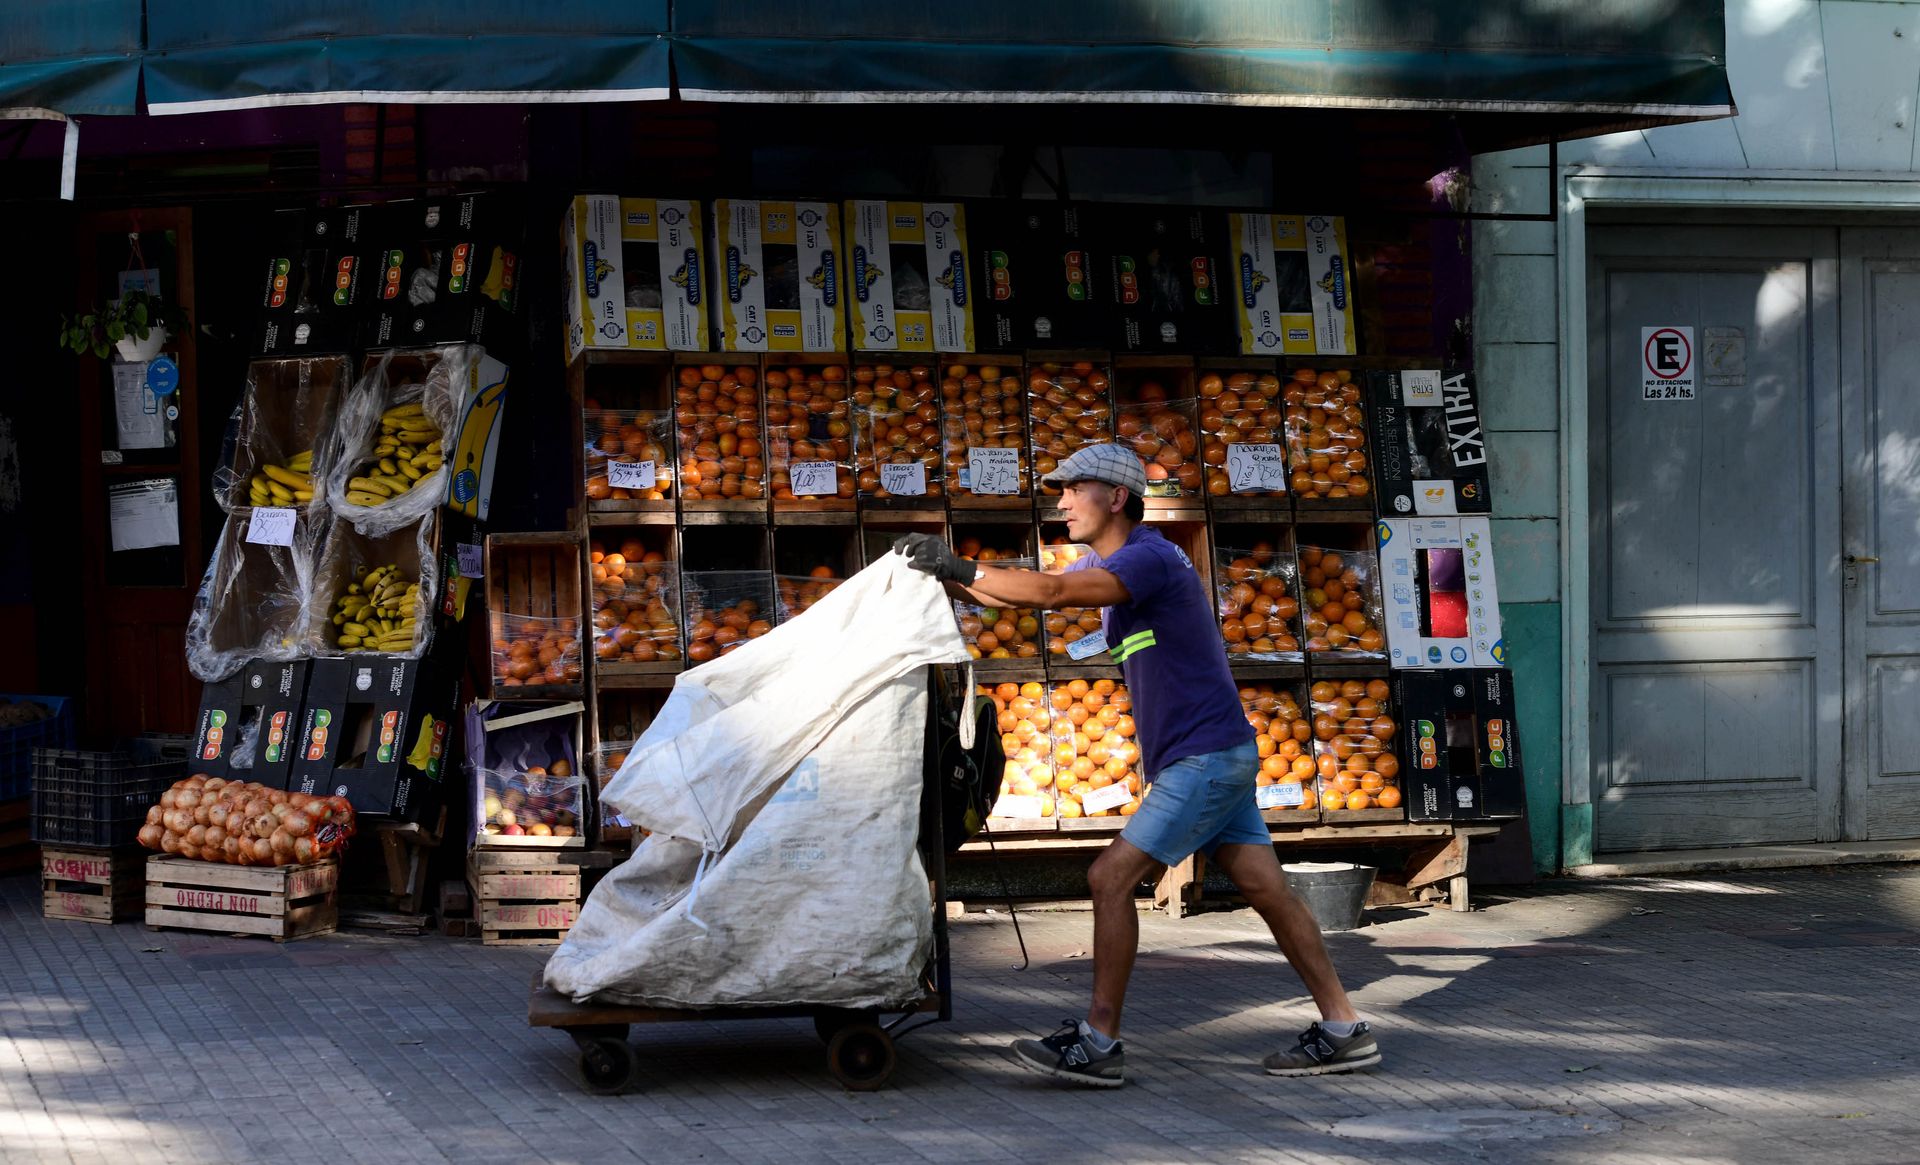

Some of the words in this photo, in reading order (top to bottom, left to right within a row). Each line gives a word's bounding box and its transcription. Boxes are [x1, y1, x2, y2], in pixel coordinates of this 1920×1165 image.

[807, 235, 815, 249] CAT
[1316, 240, 1324, 254] CAT
[273, 260, 288, 305] FDC
[337, 258, 352, 303] FDC
[387, 252, 402, 297] FDC
[452, 246, 467, 291] FDC
[586, 243, 599, 296] SABROSTAR
[686, 250, 698, 303] SABROSTAR
[729, 249, 741, 300] SABROSTAR
[823, 252, 836, 305] SABROSTAR
[855, 247, 867, 301] SABROSTAR
[951, 253, 965, 305] SABROSTAR
[993, 253, 1008, 298] FDC
[1067, 253, 1083, 298] FDC
[1121, 258, 1136, 302] FDC
[1194, 258, 1210, 303] FDC
[1242, 256, 1254, 307] SABROSTAR
[1333, 257, 1344, 309] SABROSTAR
[606, 301, 614, 315] CAT
[747, 305, 755, 319] CAT
[1262, 310, 1270, 325] CAT
[1656, 338, 1680, 369] E
[1411, 384, 1434, 395] EXTRA
[1645, 387, 1661, 399] Las
[1665, 387, 1677, 398] 24
[1679, 386, 1693, 398] hs.
[1386, 407, 1395, 426] P.A.
[1443, 372, 1487, 468] EXTRA
[1388, 428, 1402, 481] SELEZIONI
[205, 713, 225, 757] FDC
[267, 714, 285, 759] FDC
[310, 712, 329, 757] FDC
[379, 713, 395, 759] FDC
[427, 723, 444, 775] FDC
[1420, 723, 1435, 767] FDC
[1489, 721, 1503, 765] FDC
[176, 889, 222, 911] PEDRO
[229, 894, 258, 913] DON
